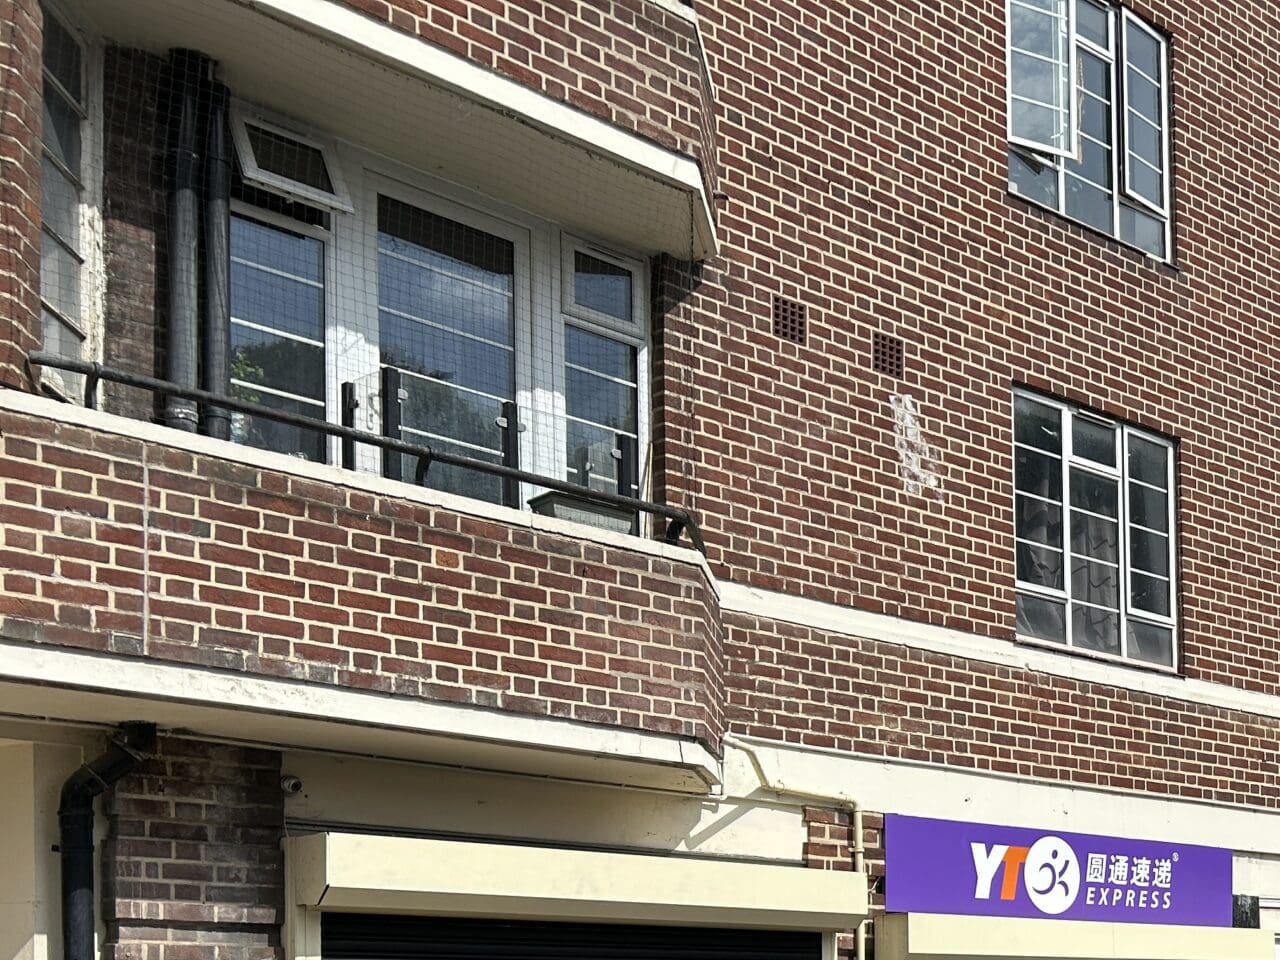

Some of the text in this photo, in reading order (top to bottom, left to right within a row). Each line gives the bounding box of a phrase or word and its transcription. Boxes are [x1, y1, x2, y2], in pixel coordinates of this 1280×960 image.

[1086, 853, 1172, 888] 圆通速递
[1086, 887, 1171, 909] EXPRESS
